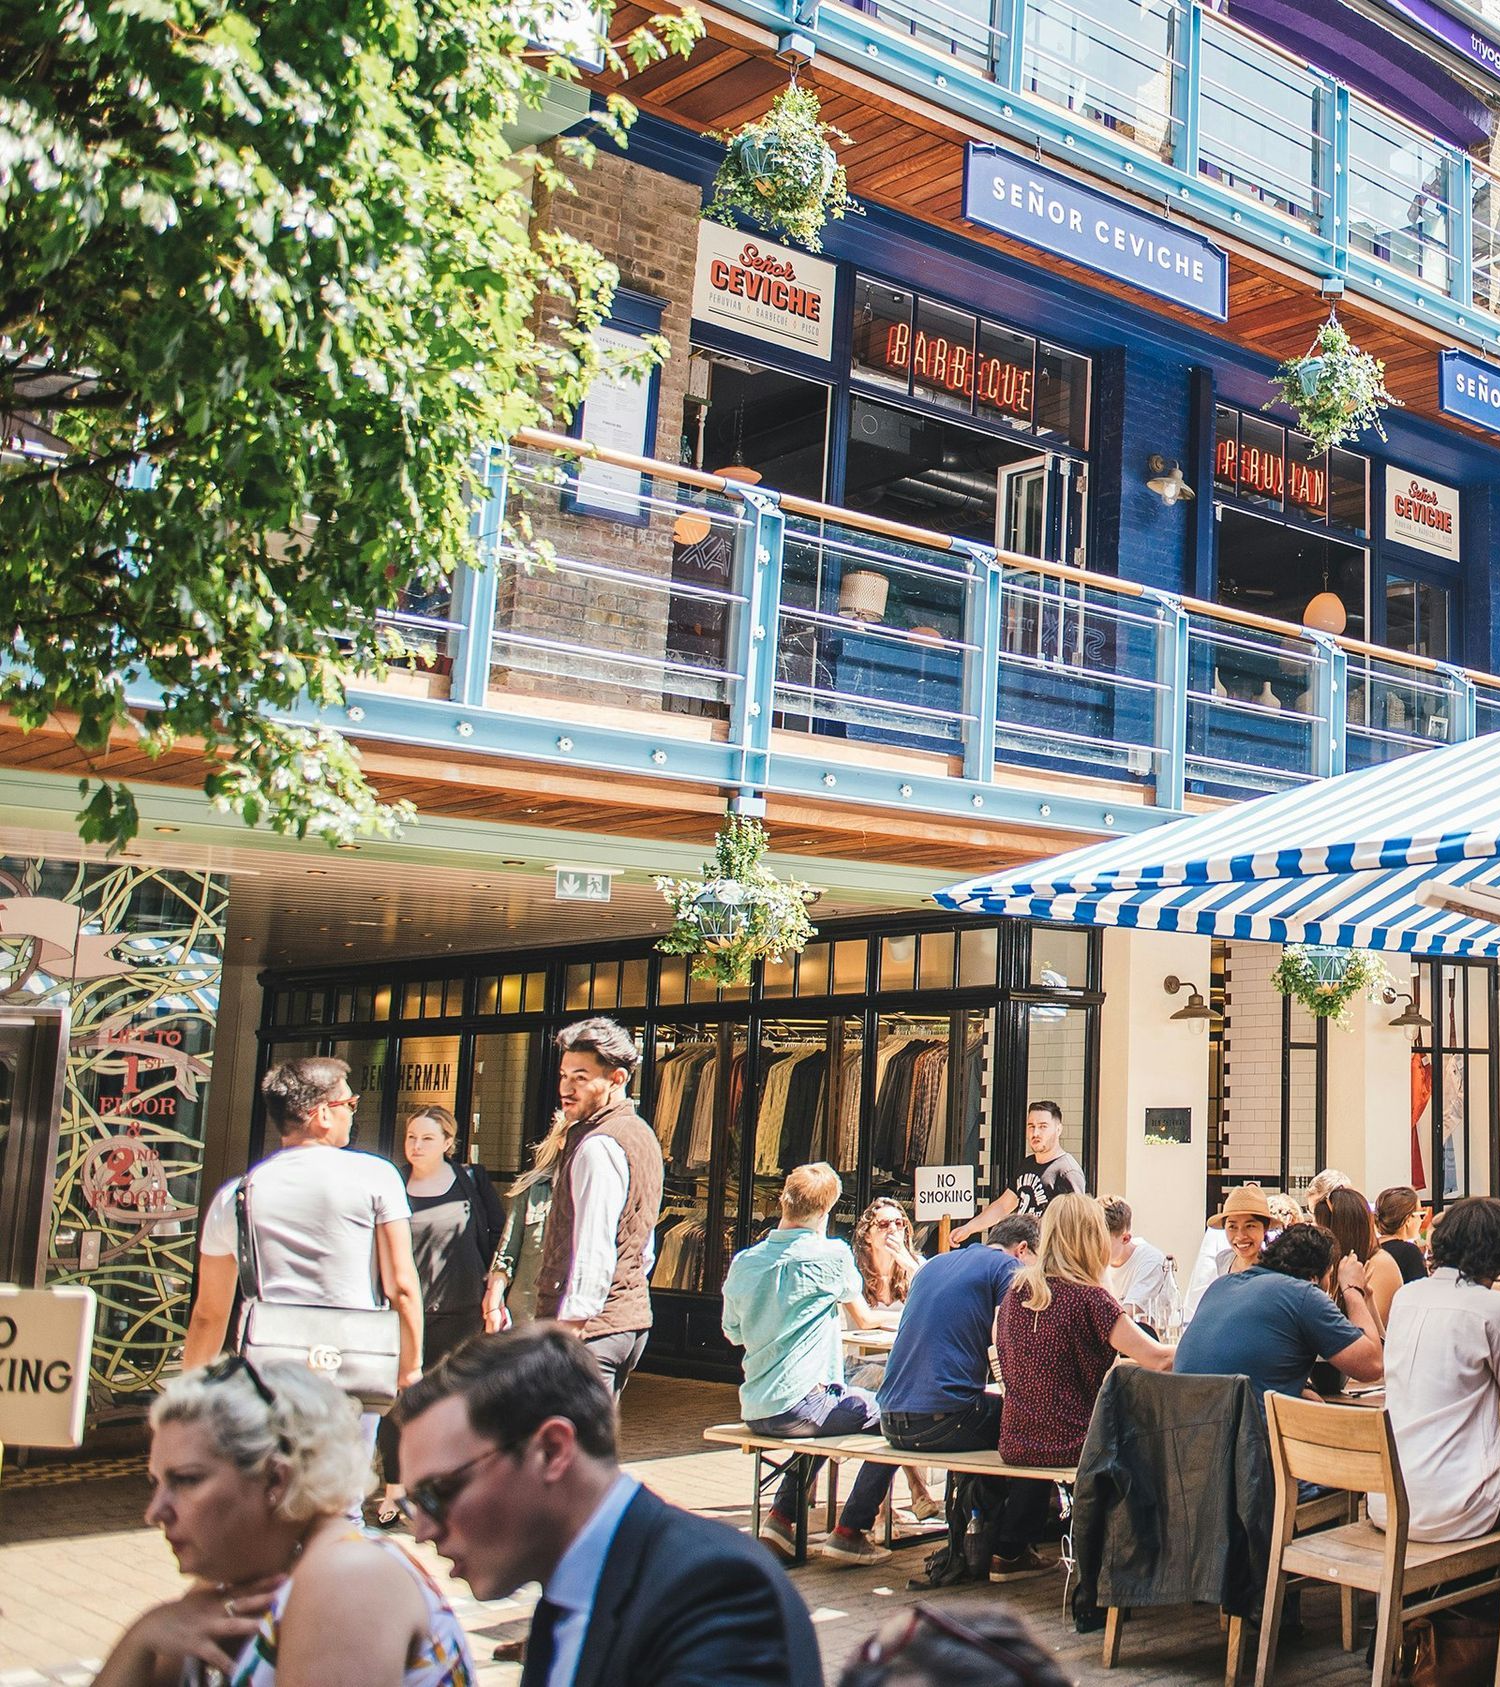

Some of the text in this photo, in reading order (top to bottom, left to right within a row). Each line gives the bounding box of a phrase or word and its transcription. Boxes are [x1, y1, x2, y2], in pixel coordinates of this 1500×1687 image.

[992, 176, 1205, 283] SEÑOR CEVICHE
[739, 243, 796, 281] Señor
[710, 259, 821, 323] CEVICHE
[709, 292, 820, 337] PERUVIAN BARBECUE PISCO
[1394, 494, 1452, 535] CEVICHE
[107, 1029, 182, 1046] LIFT TO
[399, 1063, 451, 1091] HERMAN
[100, 1097, 176, 1116] FLOOR
[126, 1121, 143, 1139] &
[937, 1173, 956, 1188] NO
[91, 1190, 168, 1208] FLOOR
[919, 1189, 973, 1204] SMOKING
[0, 1358, 73, 1393] ING
